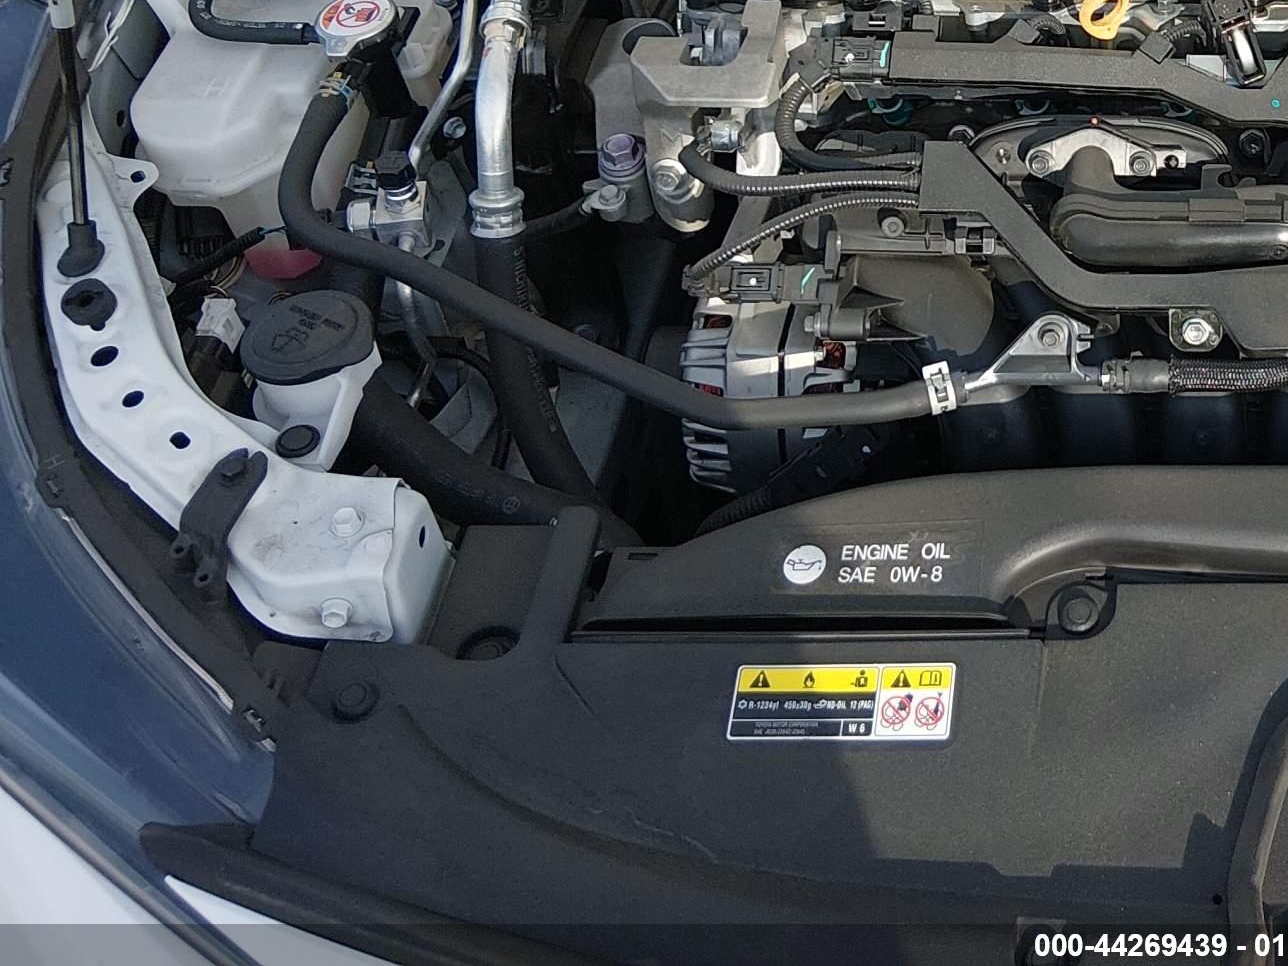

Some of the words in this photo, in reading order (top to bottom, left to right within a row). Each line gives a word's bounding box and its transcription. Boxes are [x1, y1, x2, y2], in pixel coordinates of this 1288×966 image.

[841, 543, 909, 561] ENGINE
[921, 542, 951, 560] OIL
[838, 566, 877, 583] SAE
[890, 565, 943, 583] 0W-8
[748, 700, 779, 712] R-1234yf
[850, 700, 857, 710] 12
[858, 699, 874, 711] (PAG)
[848, 722, 857, 733] W
[859, 722, 866, 733] 6
